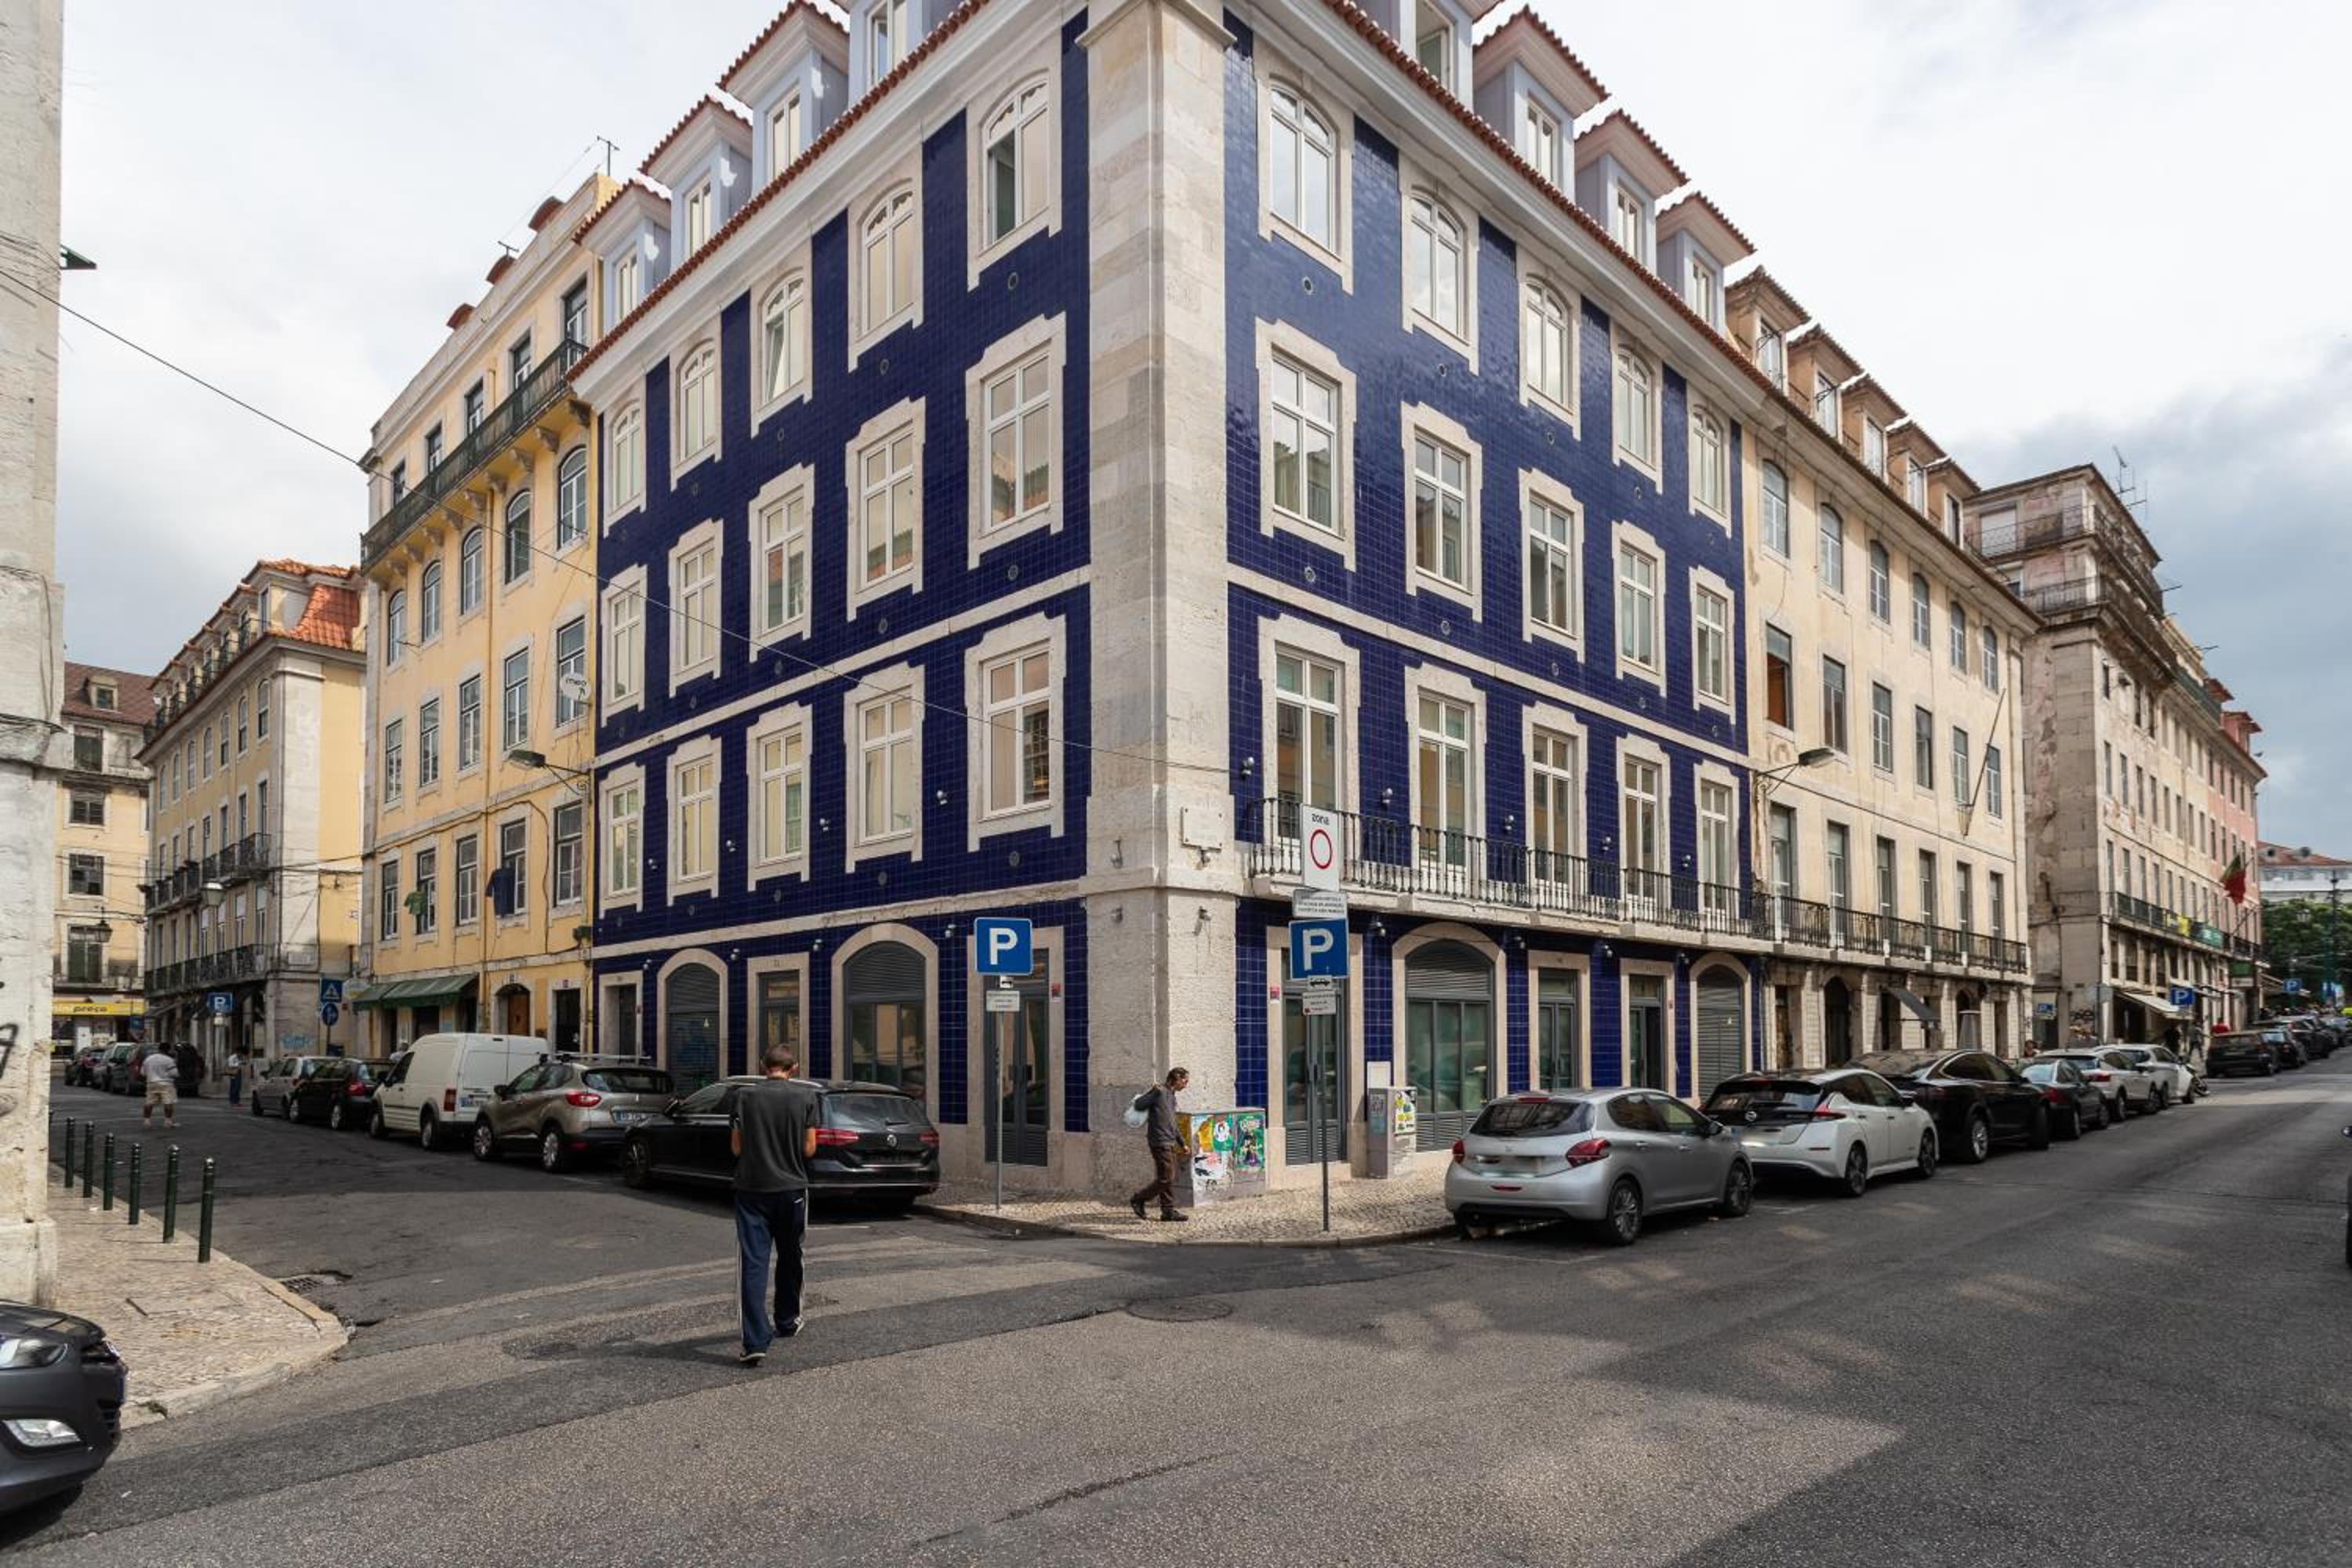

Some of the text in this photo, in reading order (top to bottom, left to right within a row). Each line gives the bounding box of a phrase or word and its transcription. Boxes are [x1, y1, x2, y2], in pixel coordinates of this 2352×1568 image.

[1311, 813, 1330, 826] zona
[989, 927, 1018, 965] P
[1303, 928, 1334, 971] P
[2287, 981, 2297, 992] P
[214, 996, 226, 1011] P
[2175, 989, 2189, 1004] P
